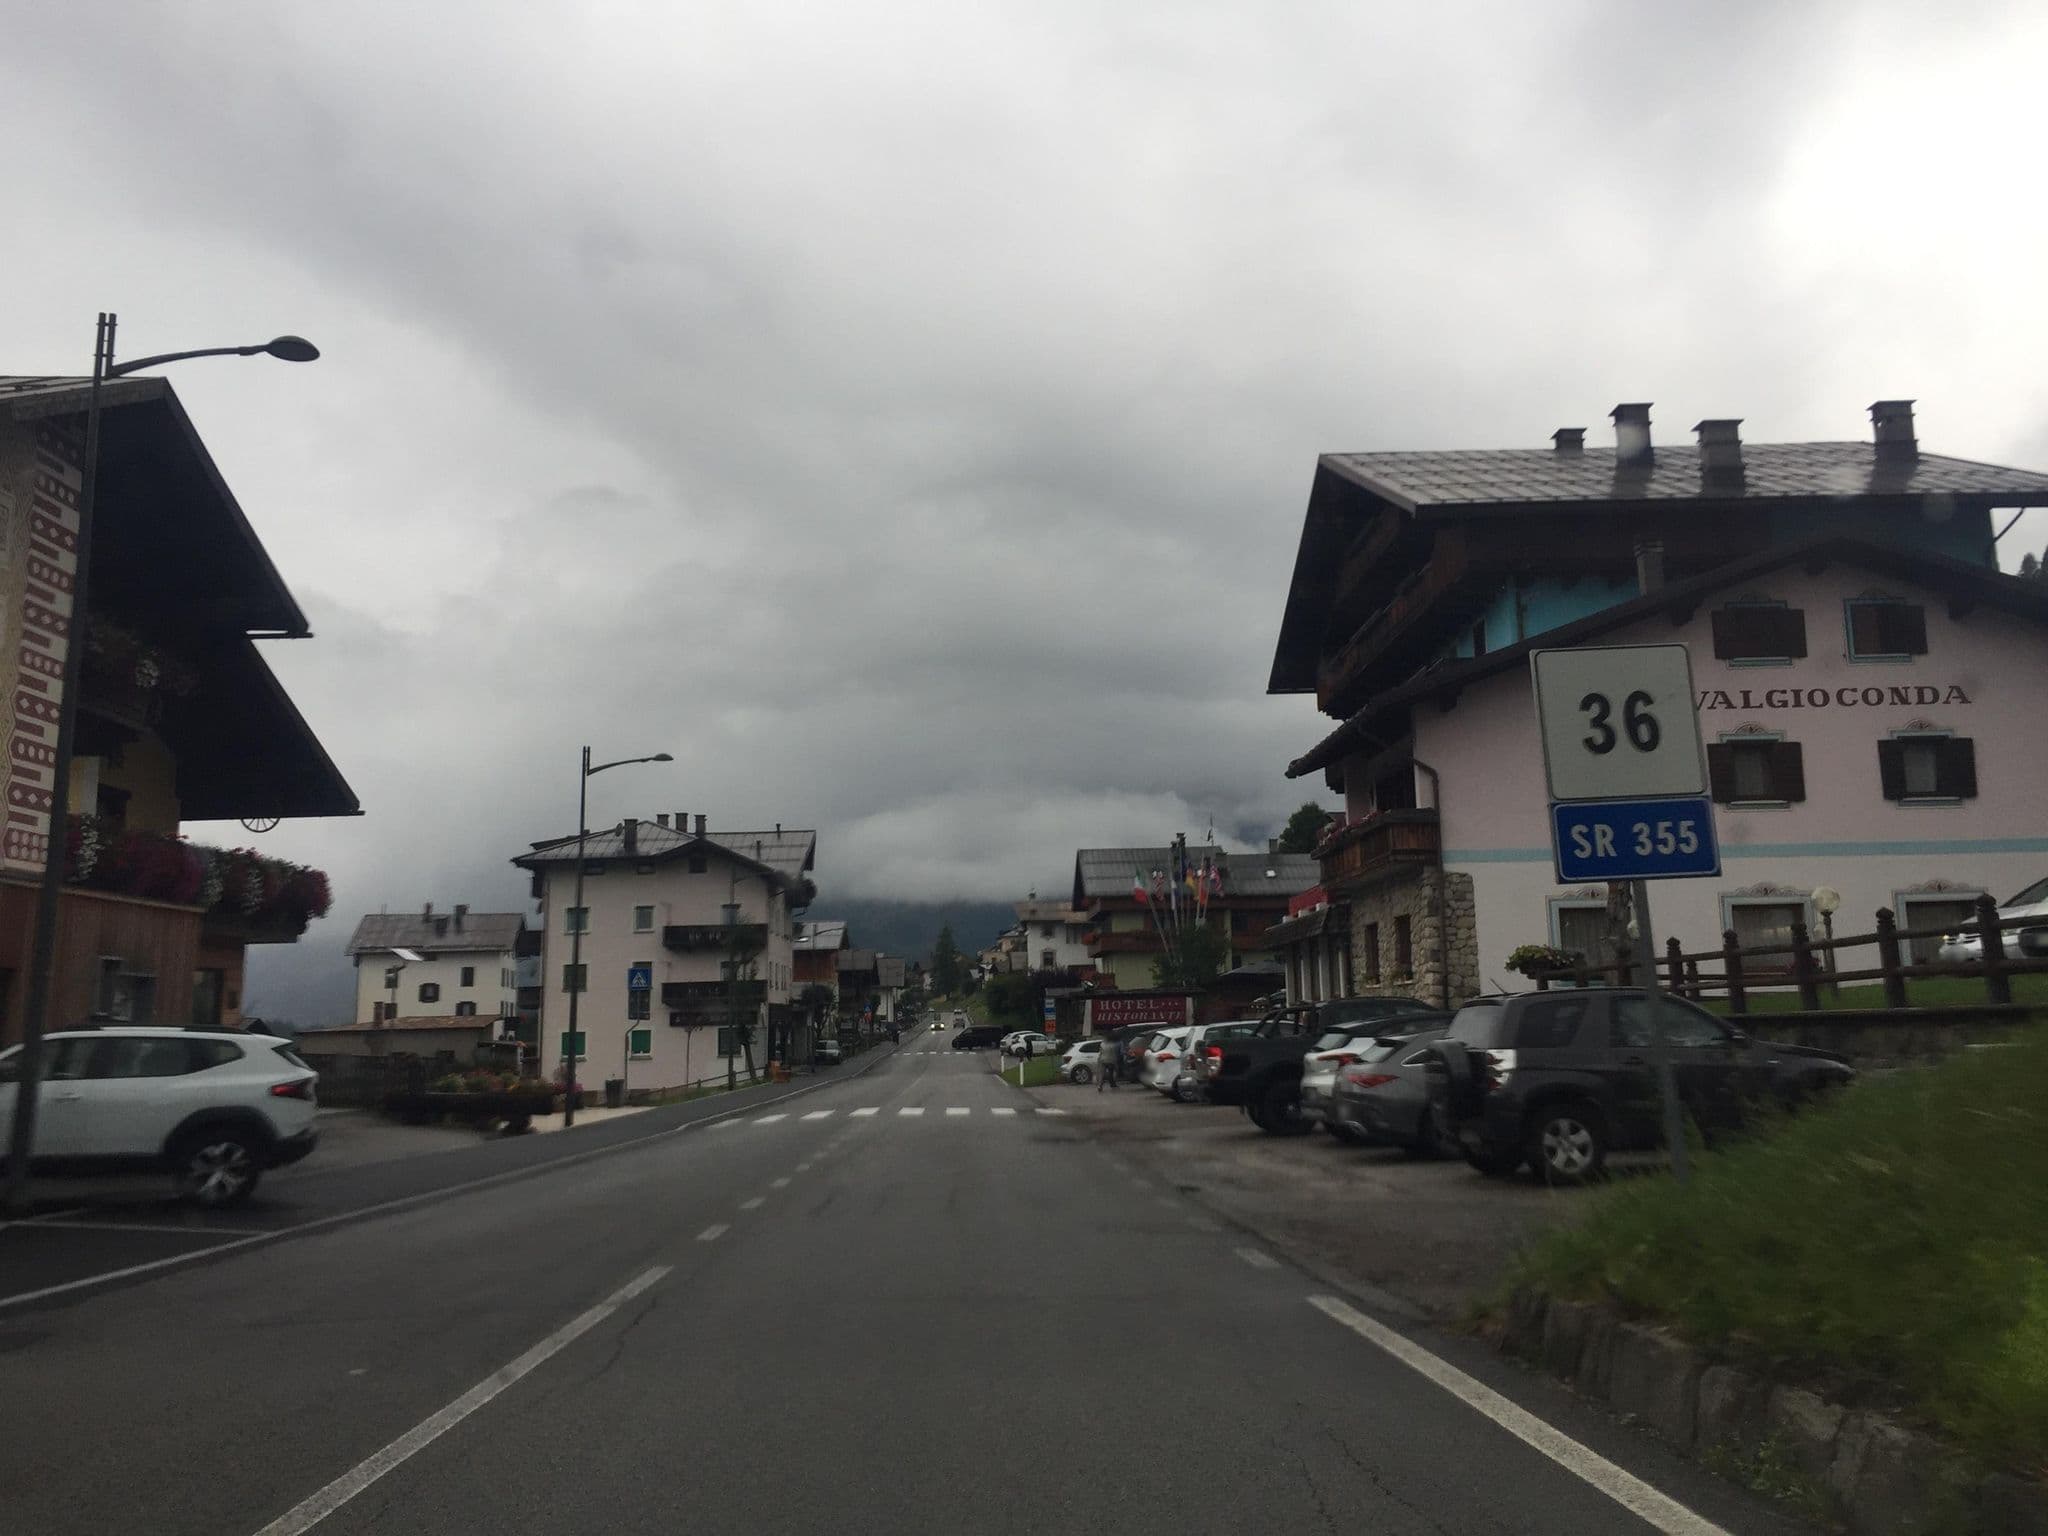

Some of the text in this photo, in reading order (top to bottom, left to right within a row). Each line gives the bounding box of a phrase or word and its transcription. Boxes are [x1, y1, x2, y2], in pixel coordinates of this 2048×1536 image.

[1579, 690, 1660, 755] 36
[1570, 820, 1699, 859] SR 355
[1100, 1000, 1159, 1010] HOTEL
